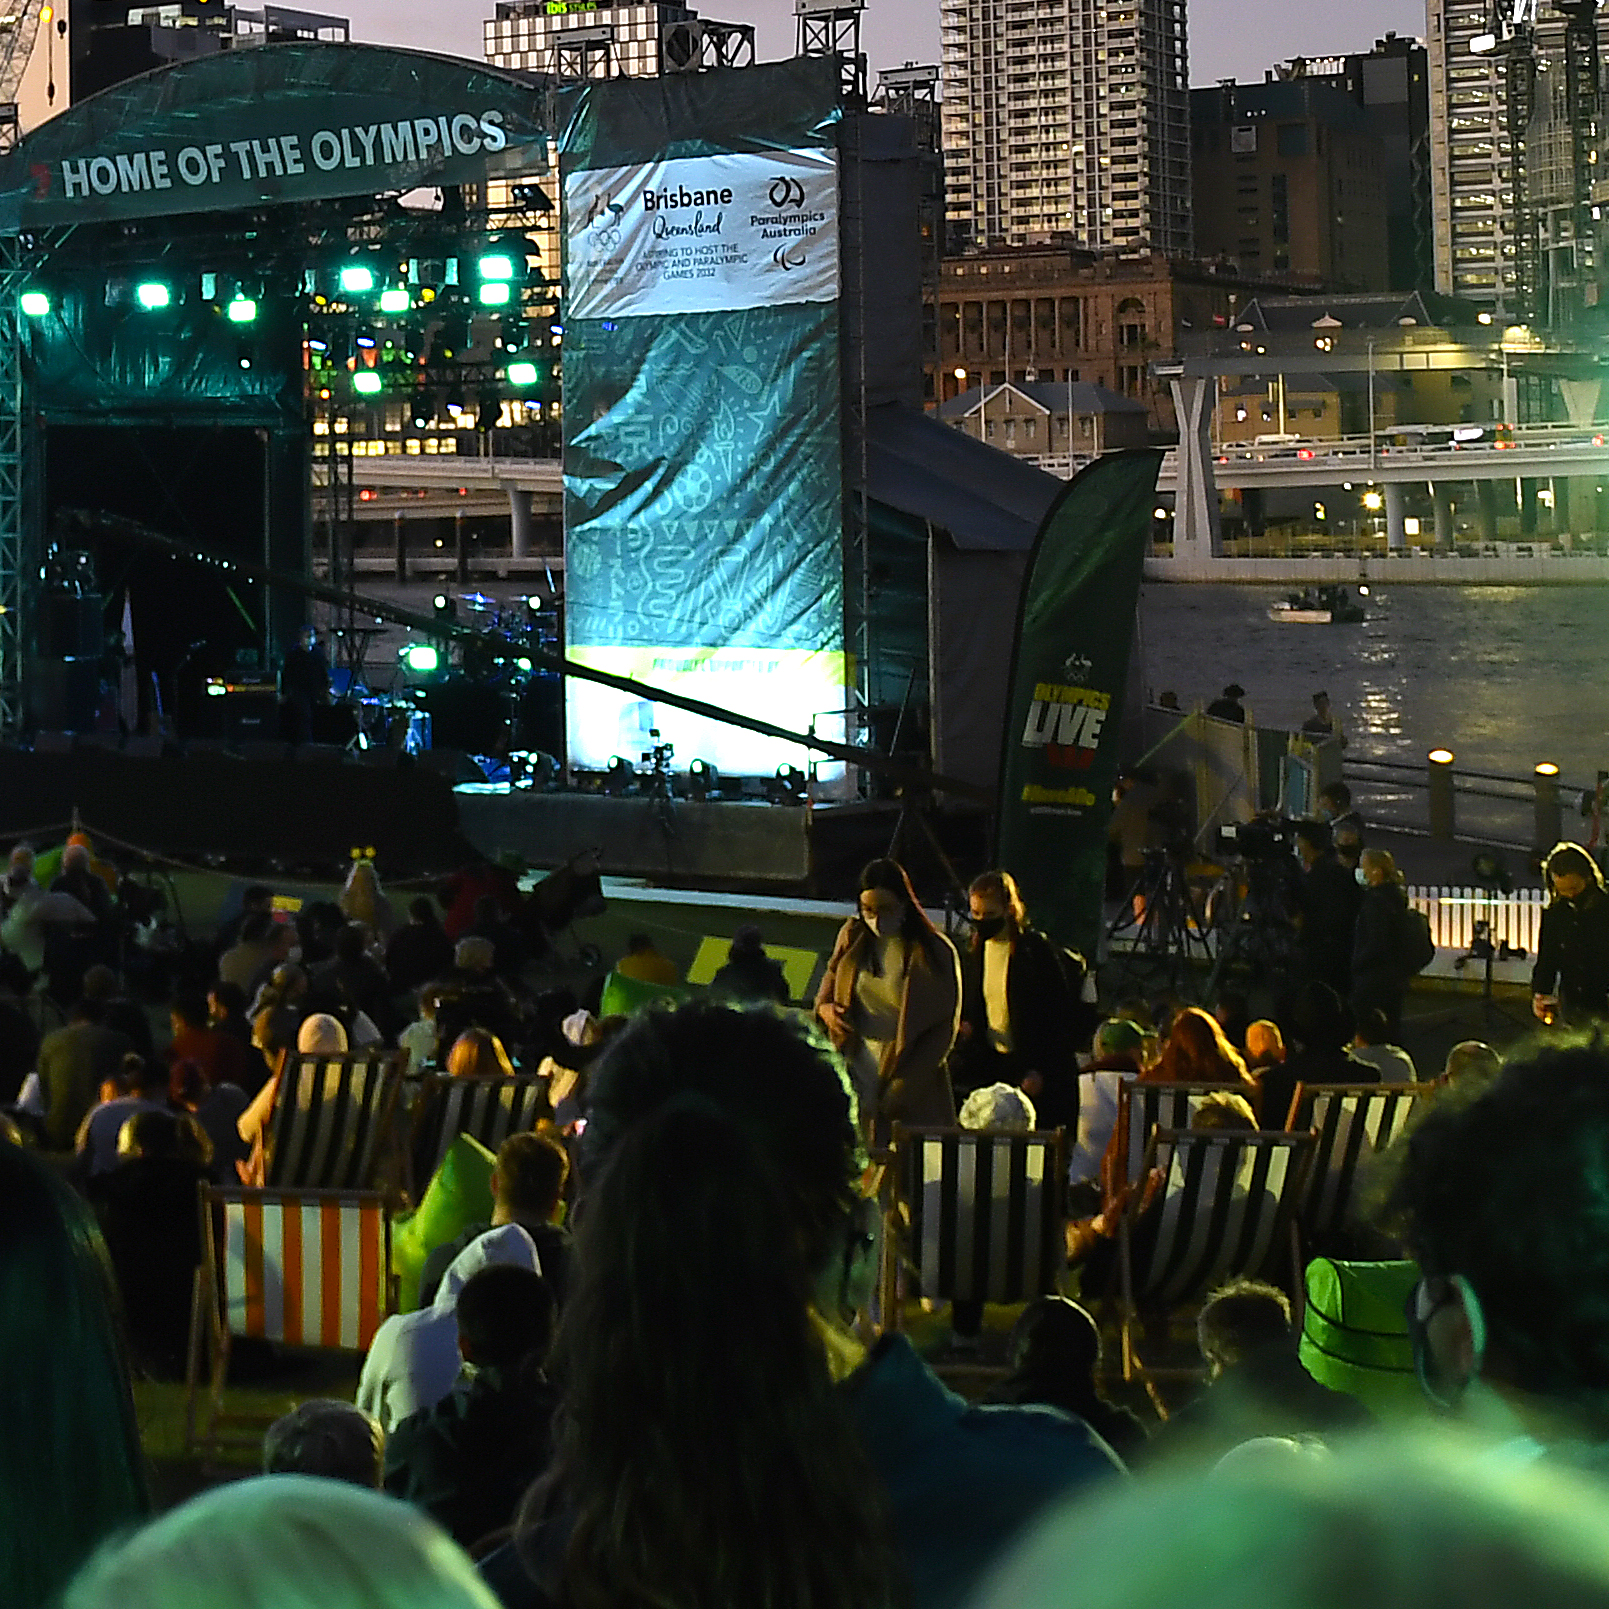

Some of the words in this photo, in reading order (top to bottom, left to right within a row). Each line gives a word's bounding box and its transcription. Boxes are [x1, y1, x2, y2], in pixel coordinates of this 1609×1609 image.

[62, 149, 173, 199] HOME
[177, 143, 228, 187] OF
[229, 134, 305, 180] THE
[310, 109, 507, 171] OLYMPICS
[643, 184, 733, 212] Brisbane
[652, 210, 724, 240] Queensland
[750, 212, 826, 228] Paralympics
[760, 225, 817, 240] Australia
[681, 246, 692, 256] TO
[693, 244, 719, 255] HOST
[720, 243, 740, 253] THE
[671, 257, 691, 268] AND
[692, 253, 749, 267] PARALYMPIC
[662, 268, 694, 280] GAMES
[1022, 700, 1107, 749] LIVE
